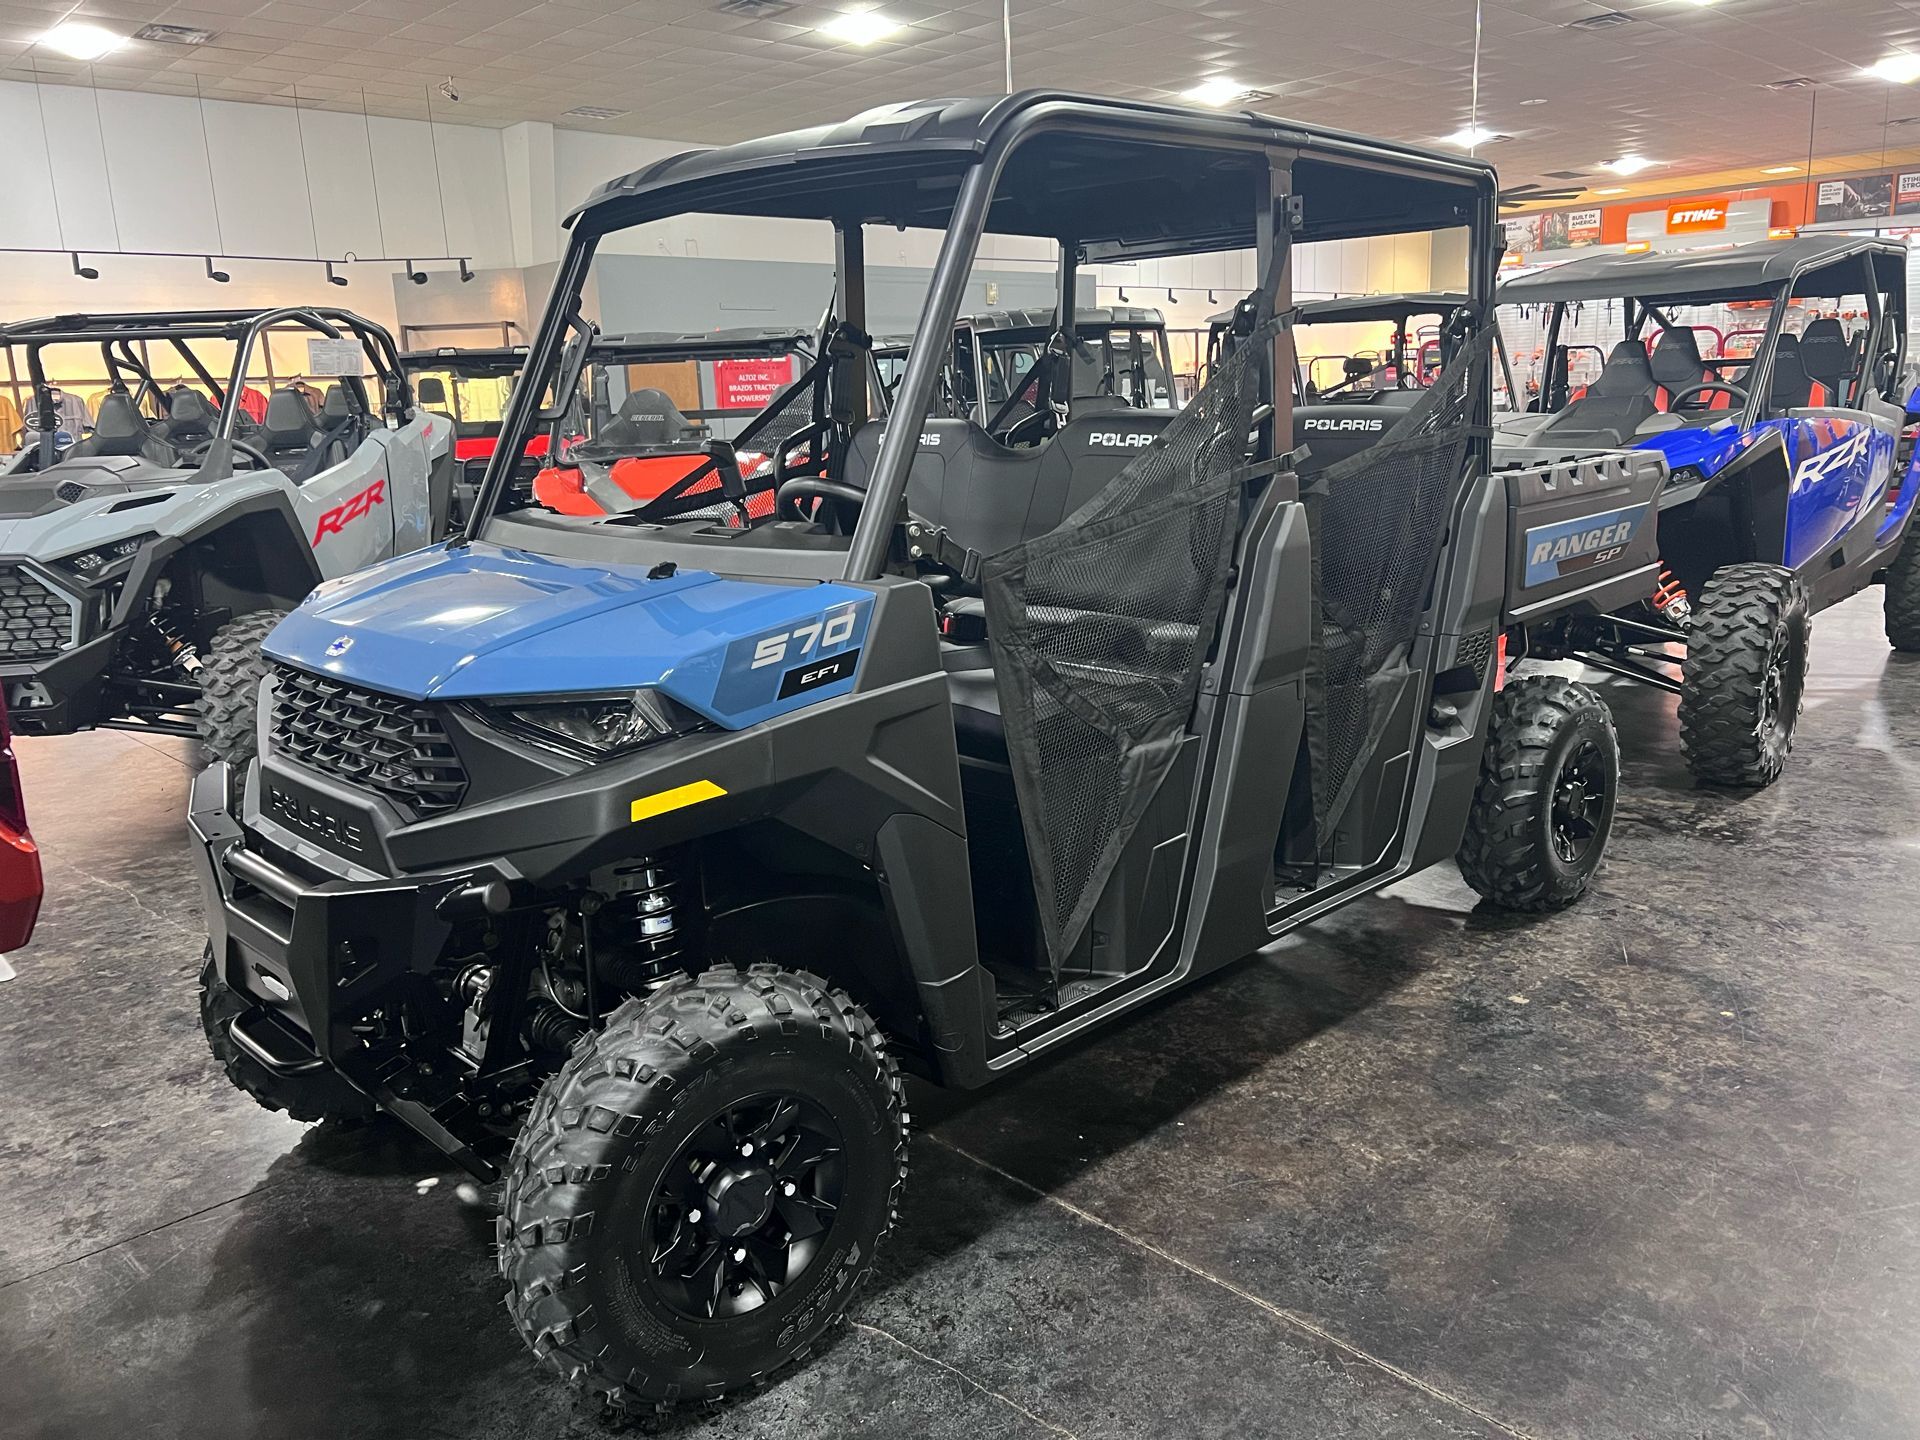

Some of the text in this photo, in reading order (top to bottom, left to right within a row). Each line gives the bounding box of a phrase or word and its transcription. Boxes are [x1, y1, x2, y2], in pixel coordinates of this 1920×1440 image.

[1571, 219, 1597, 227] AMERICA
[1671, 208, 1724, 225] STIHL
[738, 373, 770, 382] ALTOZ INC.
[729, 383, 780, 392] BRAZOS TRACTO
[737, 394, 771, 402] POWERSPO
[1304, 419, 1382, 431] POLARIS
[878, 433, 941, 446] PRIS
[1089, 432, 1164, 448] POLAR
[1793, 428, 1869, 493] RZR
[312, 480, 385, 549] RZR
[1530, 520, 1631, 566] RANGER
[1594, 546, 1622, 564] SP
[751, 612, 856, 669] 570
[800, 663, 840, 684] EFI
[269, 785, 364, 852] POLARIS
